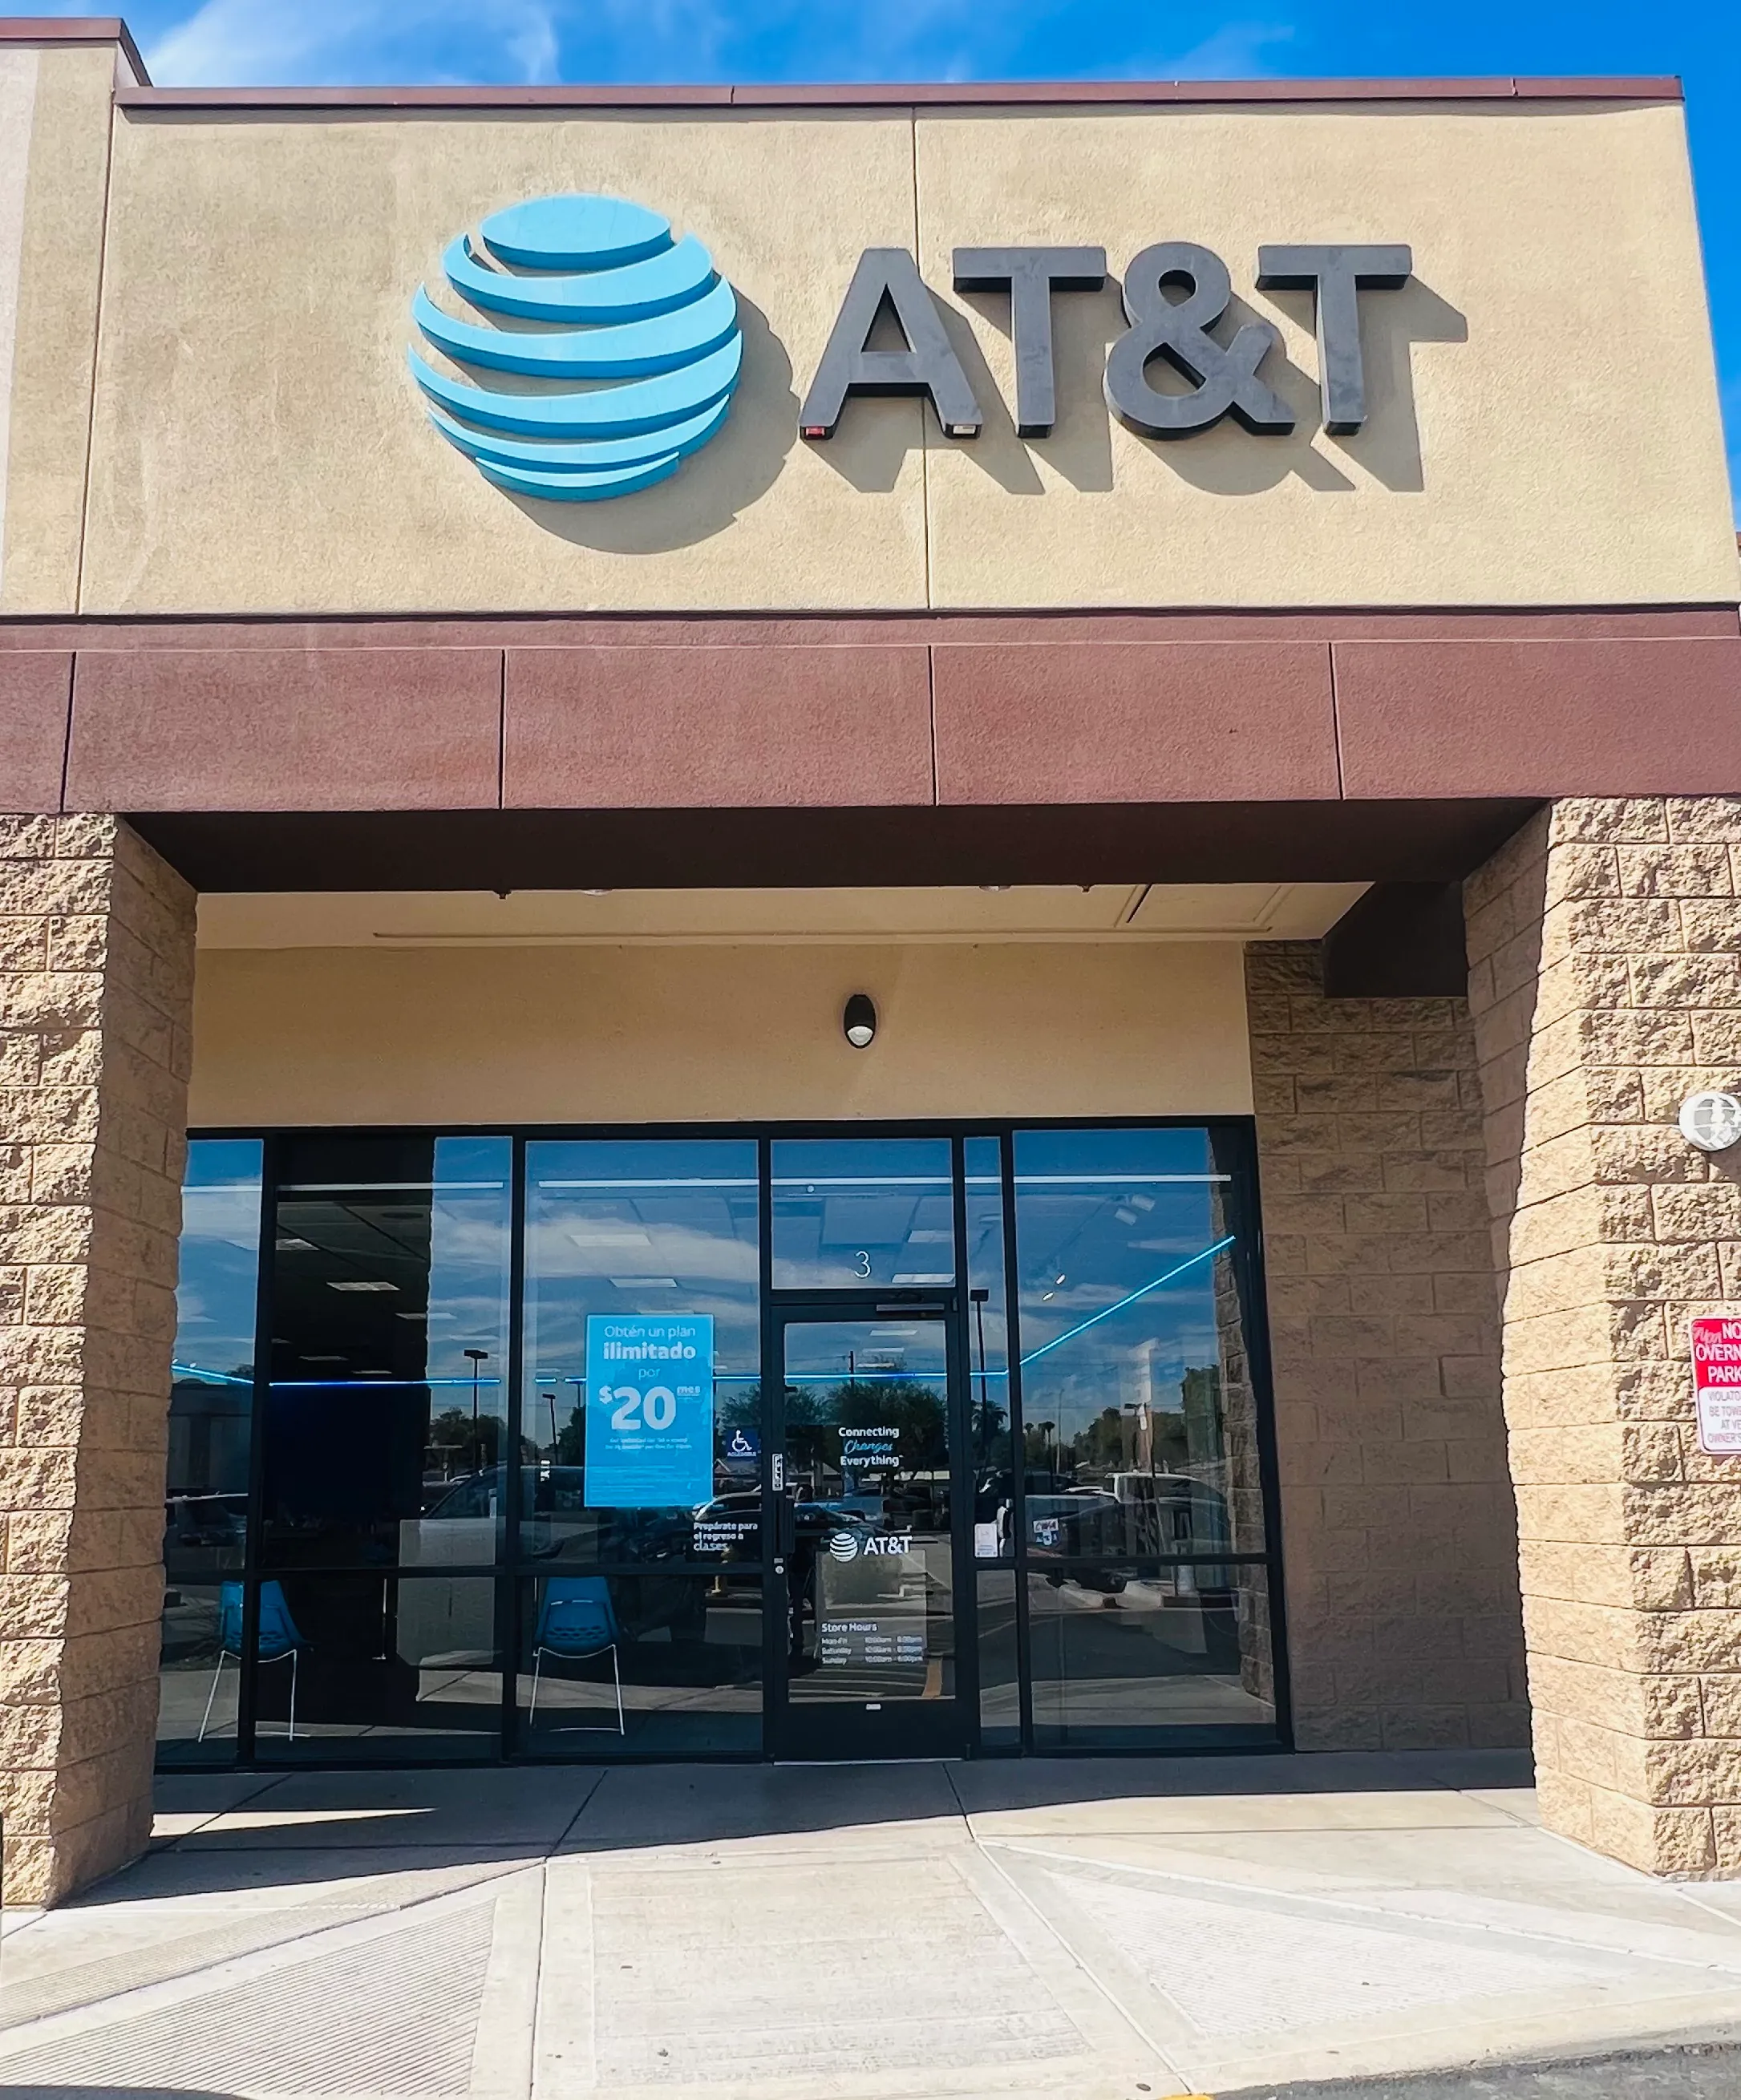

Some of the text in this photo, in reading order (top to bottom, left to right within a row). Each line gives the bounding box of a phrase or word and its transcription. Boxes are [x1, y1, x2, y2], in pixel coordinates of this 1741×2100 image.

[800, 242, 1412, 440] AT&T
[854, 1251, 872, 1278] 3
[604, 1325, 696, 1341] Obtén un plan
[1722, 1321, 1741, 1340] NO
[603, 1341, 696, 1360] ilimitado
[1695, 1342, 1741, 1362] OVERN
[638, 1368, 661, 1381] por
[1707, 1366, 1741, 1384] PARK
[599, 1386, 677, 1430] $20
[838, 1426, 900, 1438] Connecting
[844, 1438, 893, 1455] Changes
[738, 1523, 758, 1532] para
[693, 1532, 702, 1540] el
[702, 1533, 737, 1542] regreso
[863, 1535, 913, 1556] AT&T
[821, 1622, 878, 1633] Store Hours
